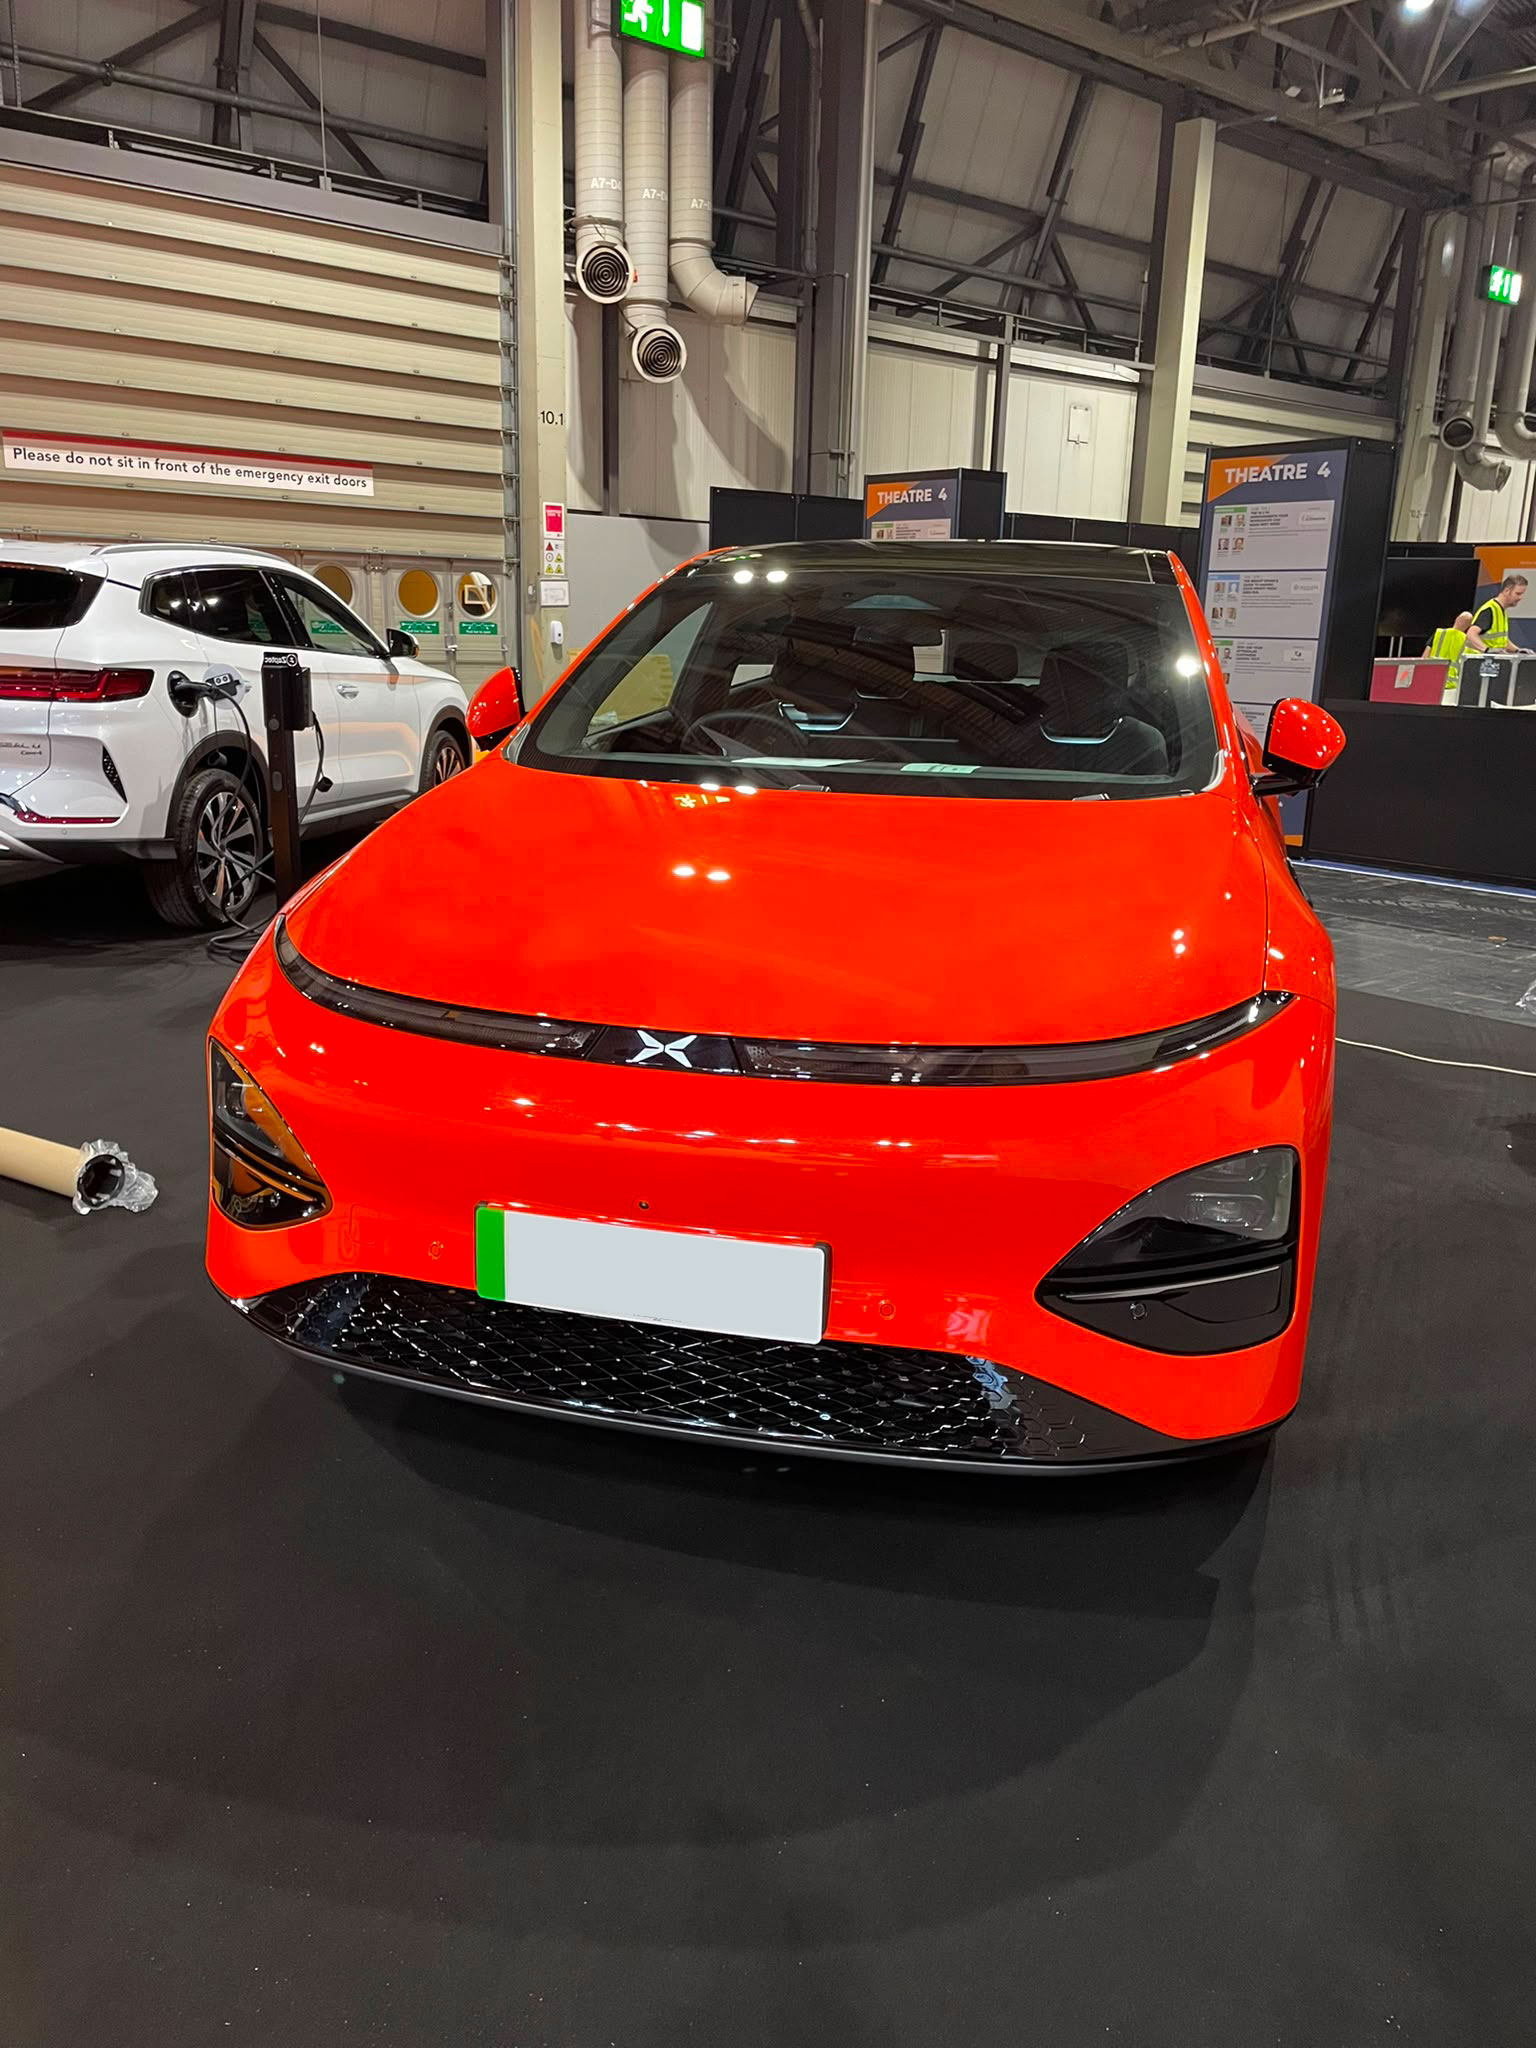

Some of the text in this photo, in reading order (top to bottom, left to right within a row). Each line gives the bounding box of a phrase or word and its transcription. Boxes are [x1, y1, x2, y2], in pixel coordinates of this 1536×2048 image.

[540, 410, 564, 426] 10.1
[13, 447, 367, 488] Please do not sit in front of the emergency exit doors
[1224, 461, 1331, 484] THEATRE 4
[877, 487, 948, 505] THEATRE 4
